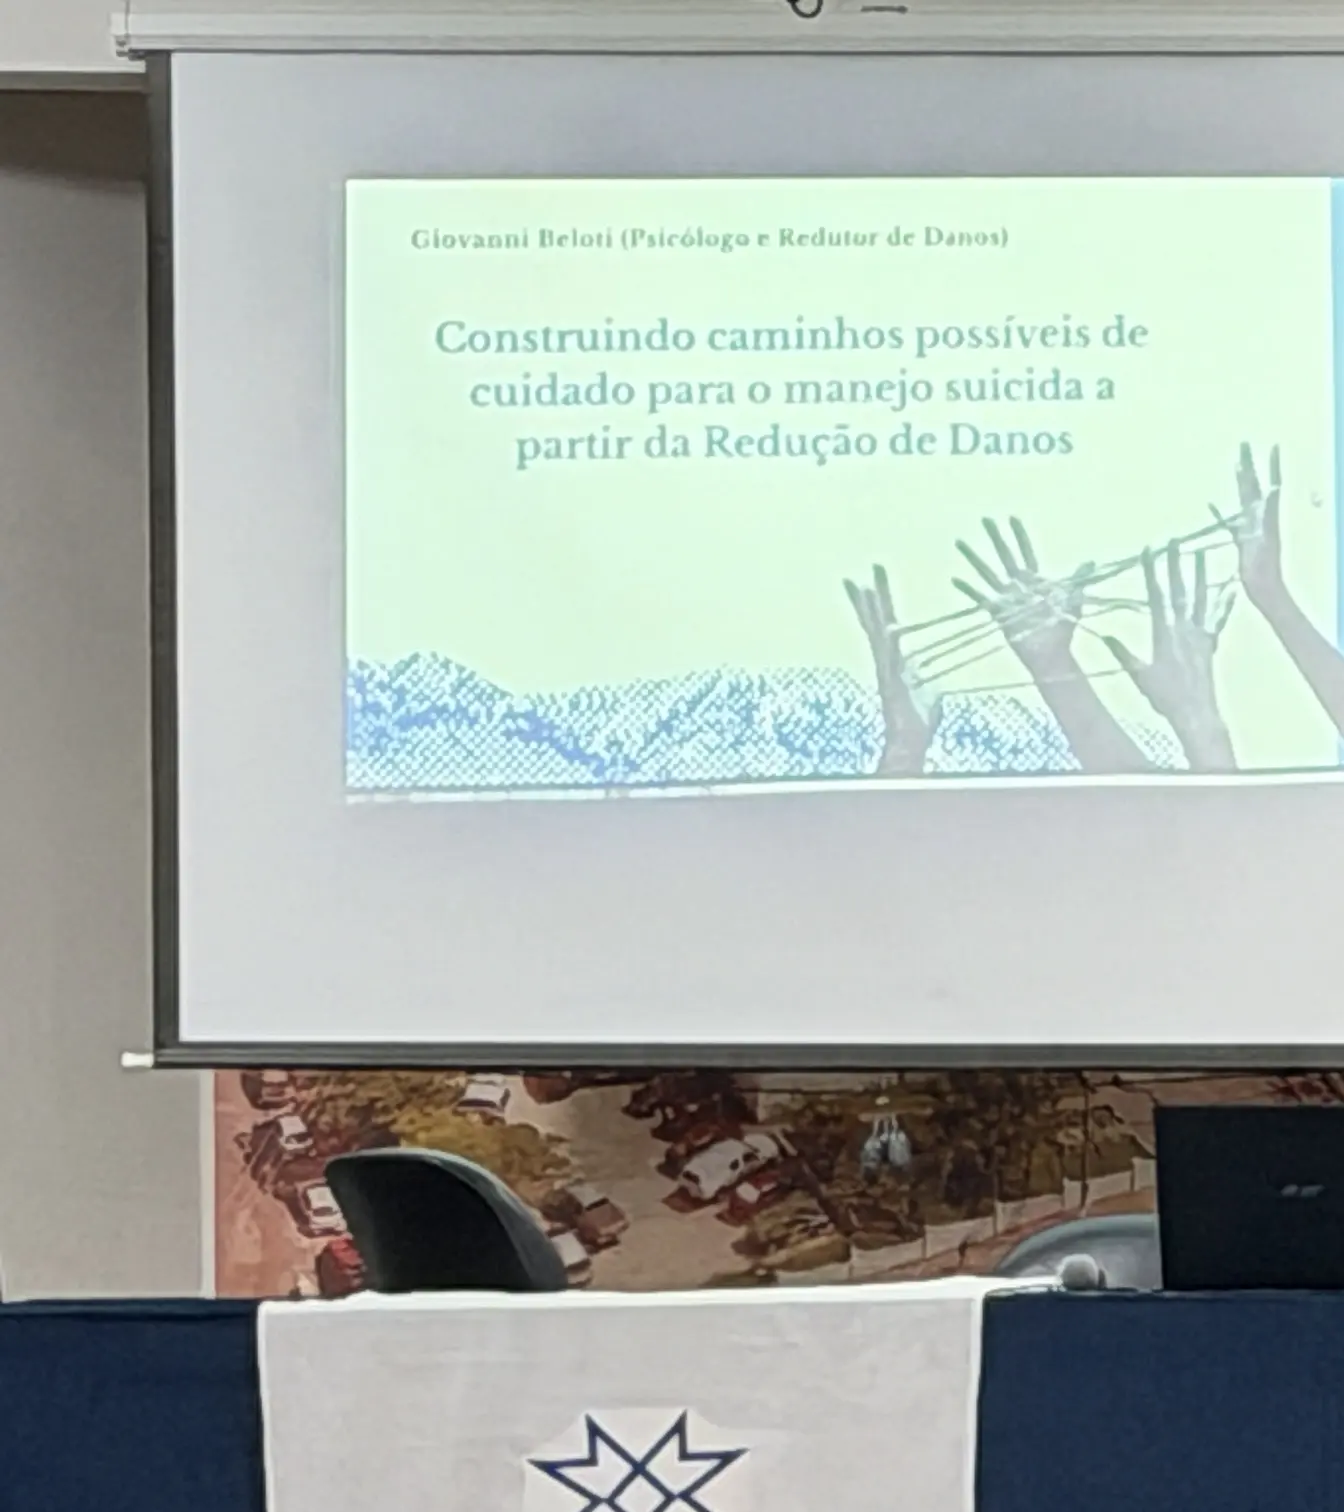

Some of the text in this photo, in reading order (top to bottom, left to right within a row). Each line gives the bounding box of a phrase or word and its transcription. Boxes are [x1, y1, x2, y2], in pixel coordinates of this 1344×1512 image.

[411, 225, 1009, 253] Giovanni Beloti (Psicólogo e Redutor de Danos)
[435, 313, 1149, 359] Construindo caminhos possíveis de
[469, 366, 1116, 414] cuidado para o manejo suicida a
[515, 421, 1074, 471] partir da Redução de Danos
